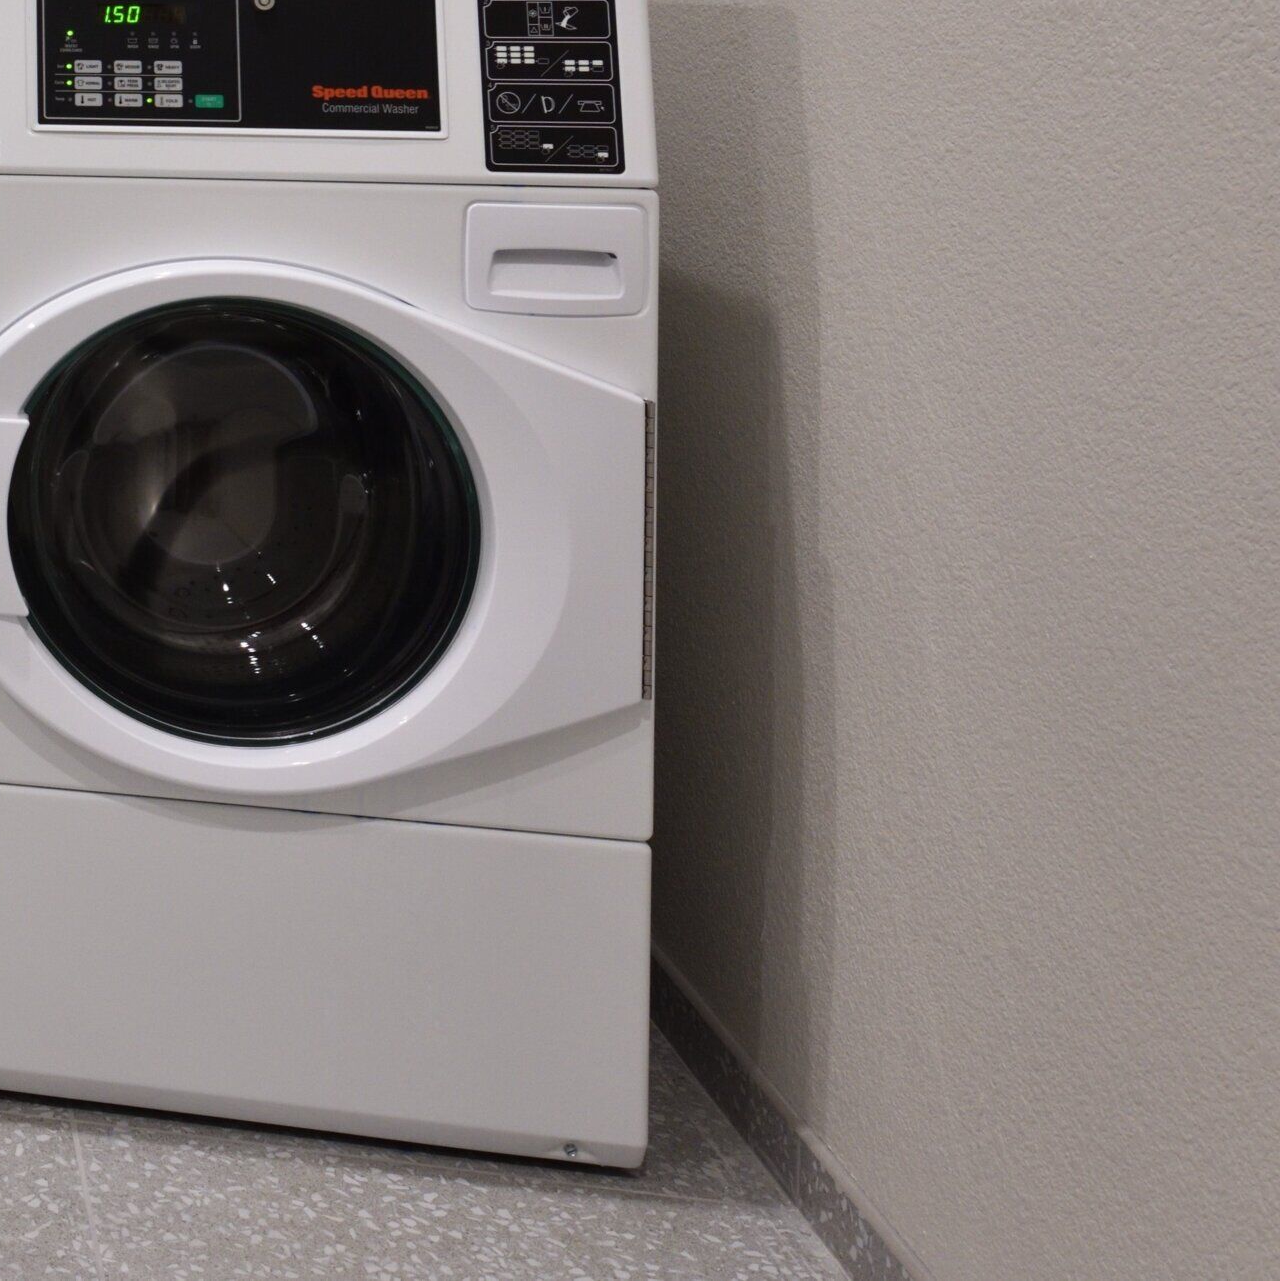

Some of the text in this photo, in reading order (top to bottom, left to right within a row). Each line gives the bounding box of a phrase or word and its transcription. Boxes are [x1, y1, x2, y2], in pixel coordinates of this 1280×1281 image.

[104, 5, 140, 23] 1.50
[312, 85, 429, 100] Speed Queen
[322, 102, 419, 114] Commercial Washer
